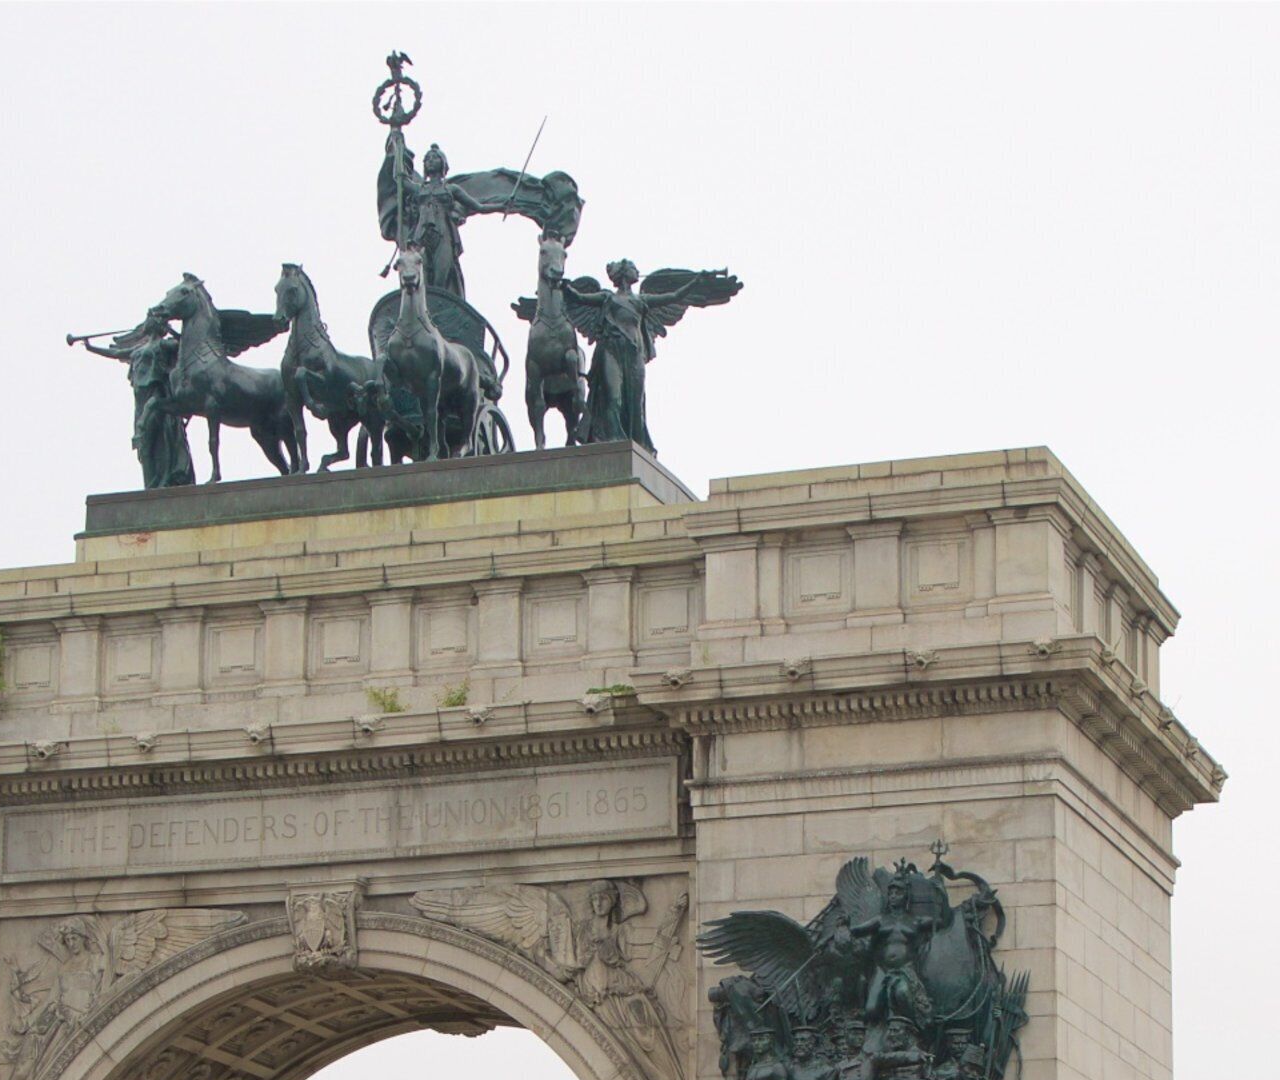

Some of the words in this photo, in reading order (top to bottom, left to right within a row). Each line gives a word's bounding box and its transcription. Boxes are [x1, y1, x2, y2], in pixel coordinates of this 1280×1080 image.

[23, 829, 55, 854] TO
[66, 824, 118, 853] THE
[129, 811, 298, 851] DEFENDERS
[312, 807, 351, 837] OF
[358, 804, 414, 834] THE
[423, 796, 508, 830] UNION
[520, 790, 570, 822] 1861
[585, 785, 650, 818] 1865
